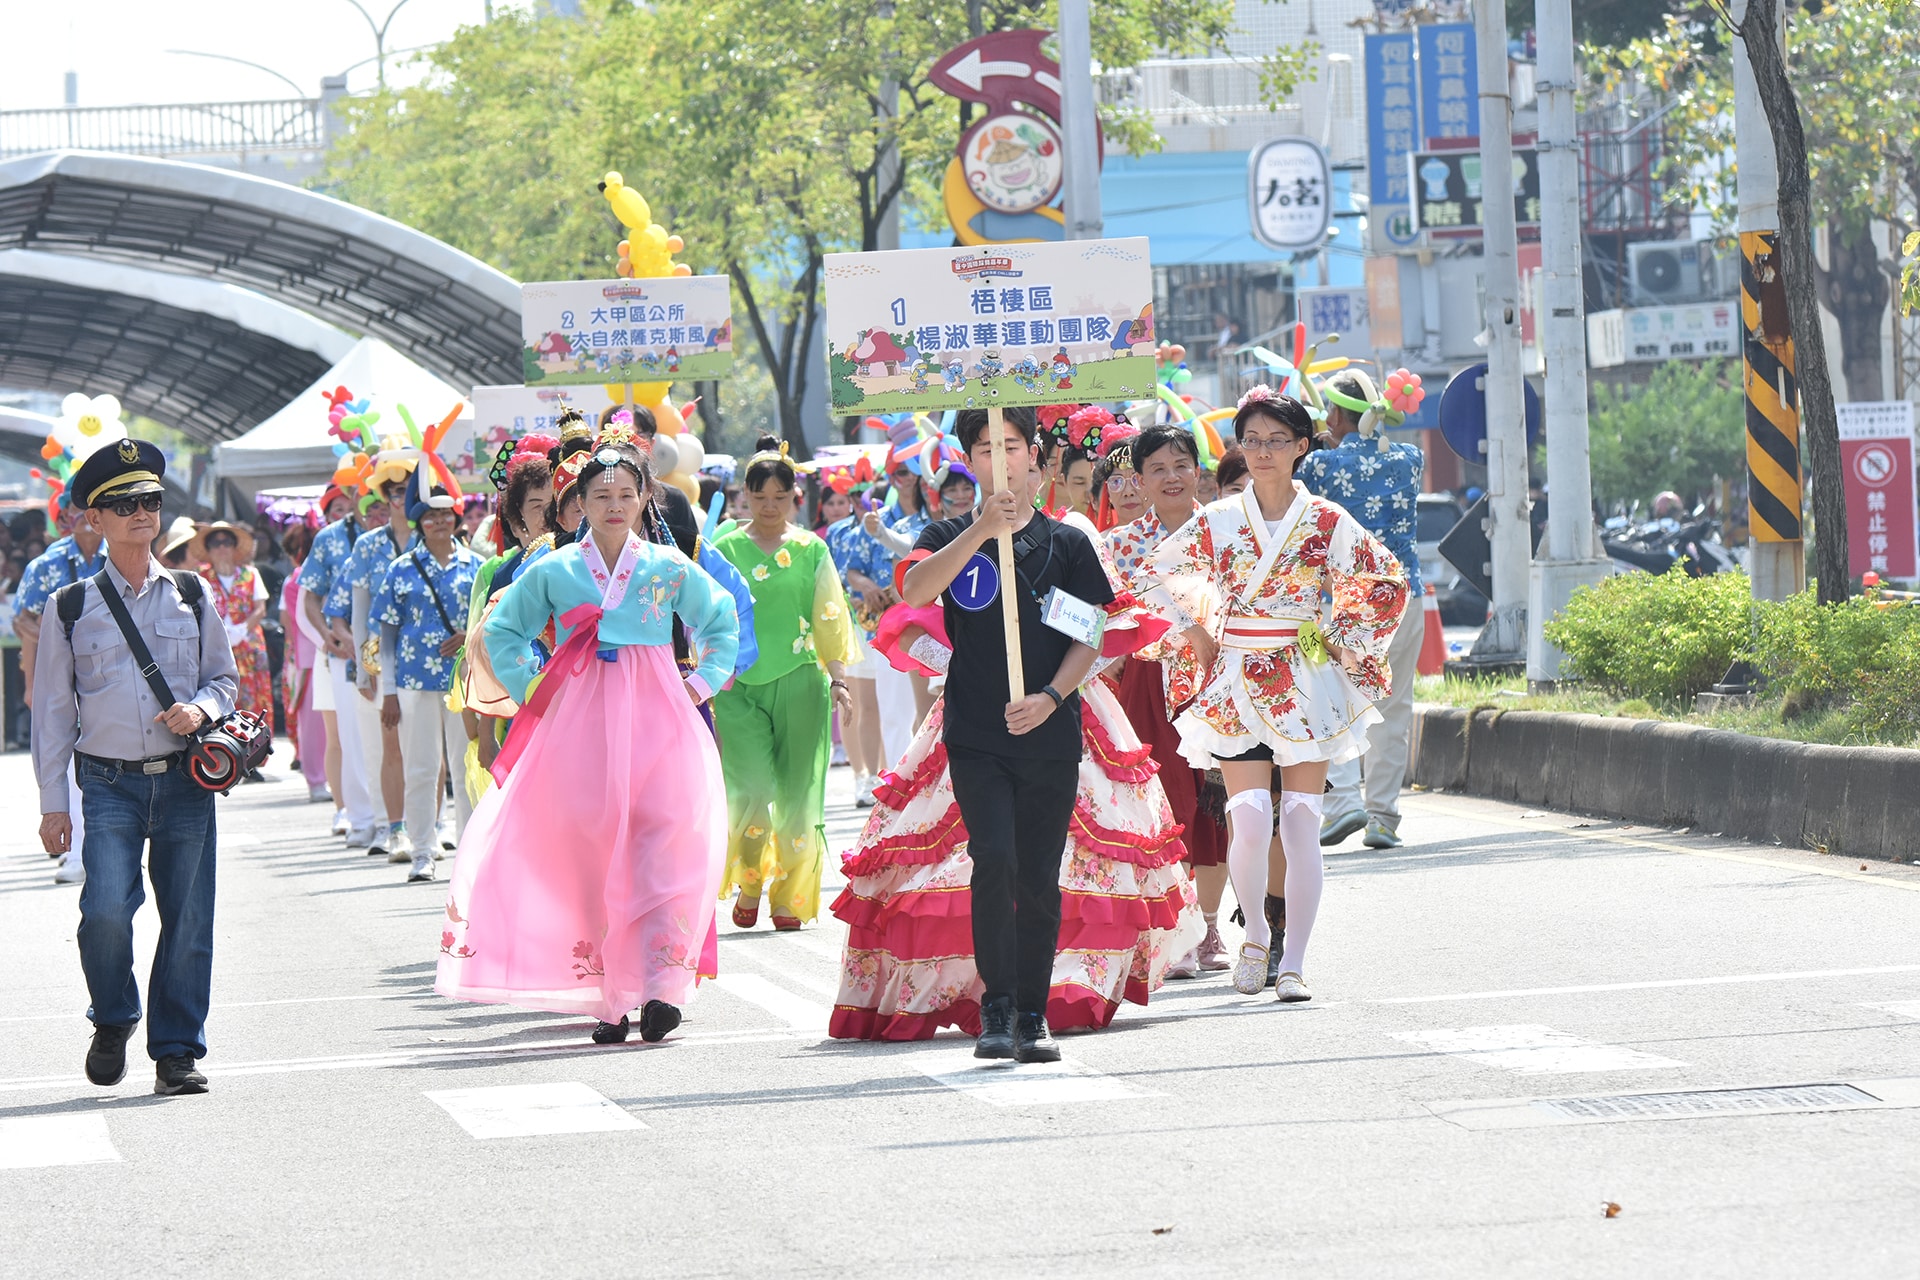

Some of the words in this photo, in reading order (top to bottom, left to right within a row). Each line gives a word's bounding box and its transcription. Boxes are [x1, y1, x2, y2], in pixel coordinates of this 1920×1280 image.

[591, 304, 685, 324] 大甲區公所
[891, 297, 906, 326] 1
[971, 286, 1053, 314] 梧棲區
[562, 311, 574, 329] 2
[916, 316, 1112, 350] 楊淑華運動團隊
[572, 326, 705, 348] 大自然薩克斯風
[1867, 490, 1889, 572] 禁止停車
[966, 565, 980, 598] 1
[1301, 628, 1320, 651] 日本
